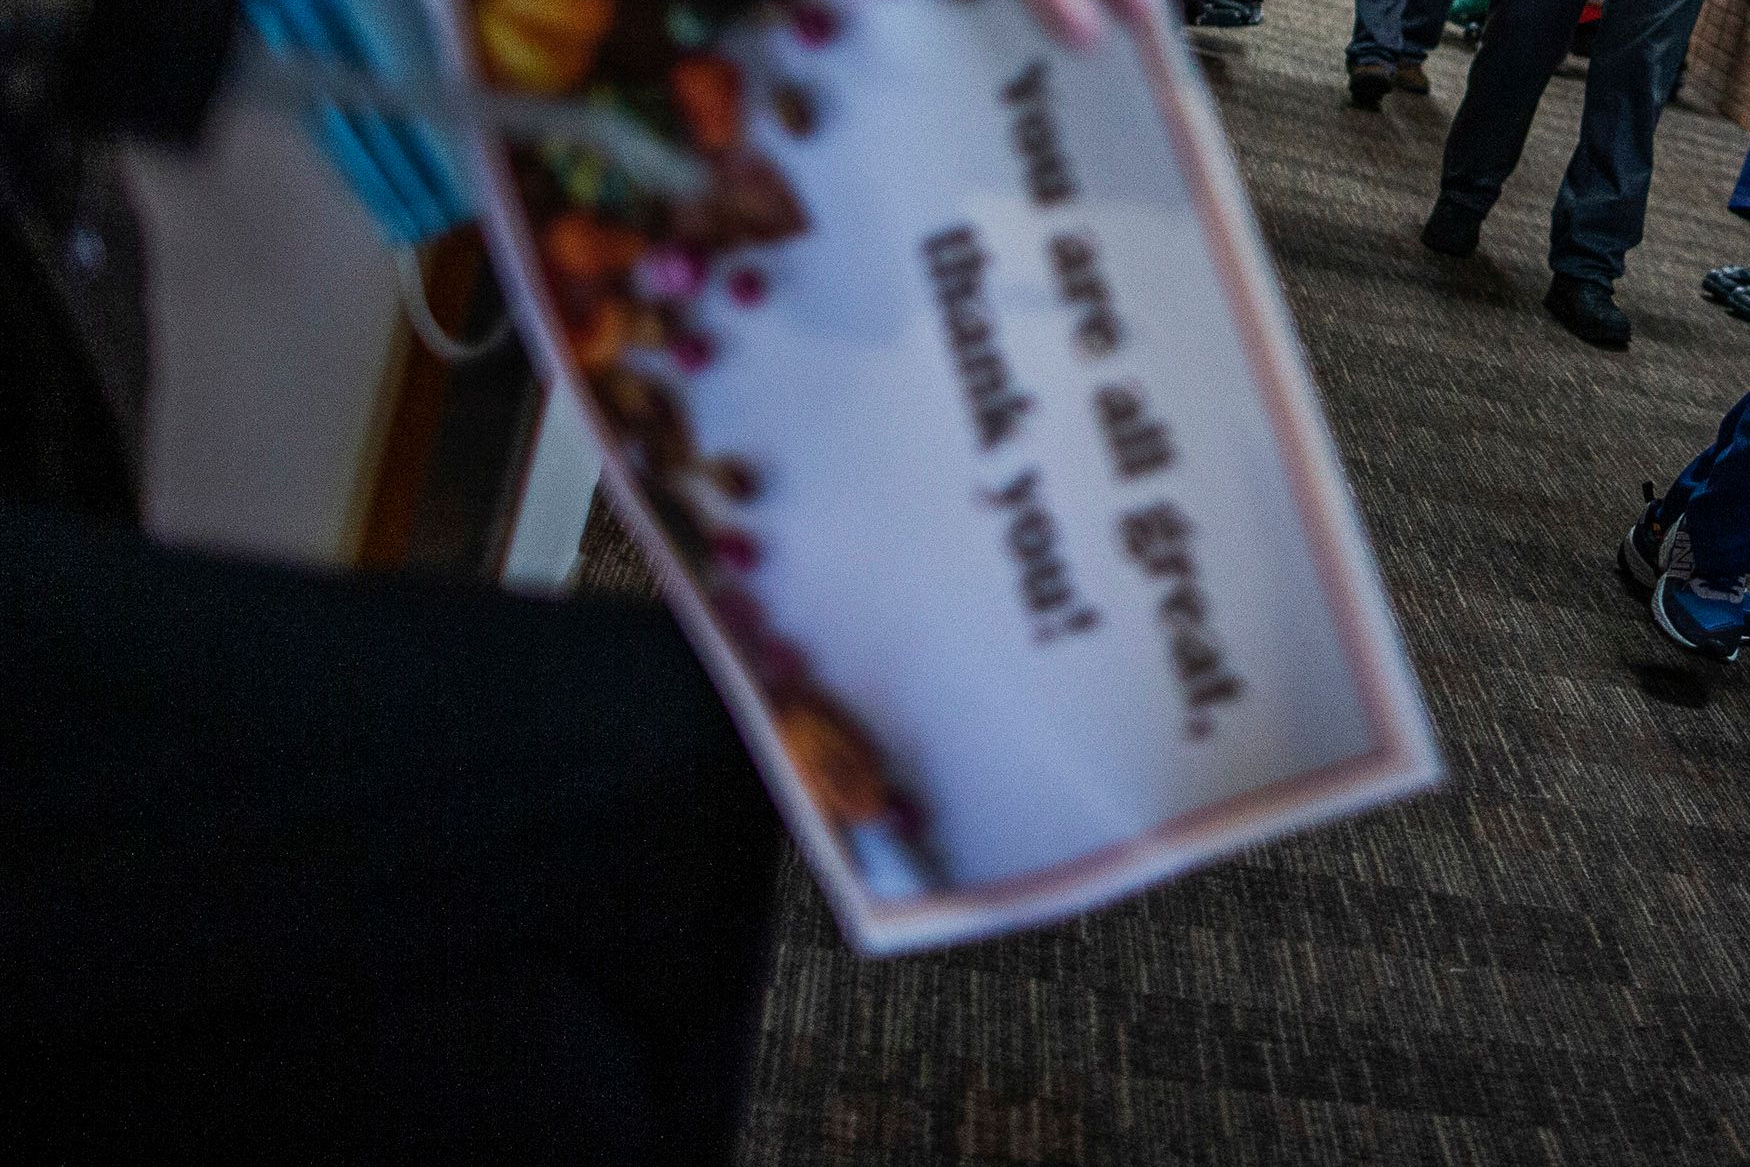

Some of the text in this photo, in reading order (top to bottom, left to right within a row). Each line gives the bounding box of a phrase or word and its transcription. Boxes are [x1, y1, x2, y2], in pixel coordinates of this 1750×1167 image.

[1049, 235, 1124, 357] are
[920, 226, 1099, 645] thank you!
[1096, 382, 1177, 479] all
[1119, 502, 1245, 741] great,
